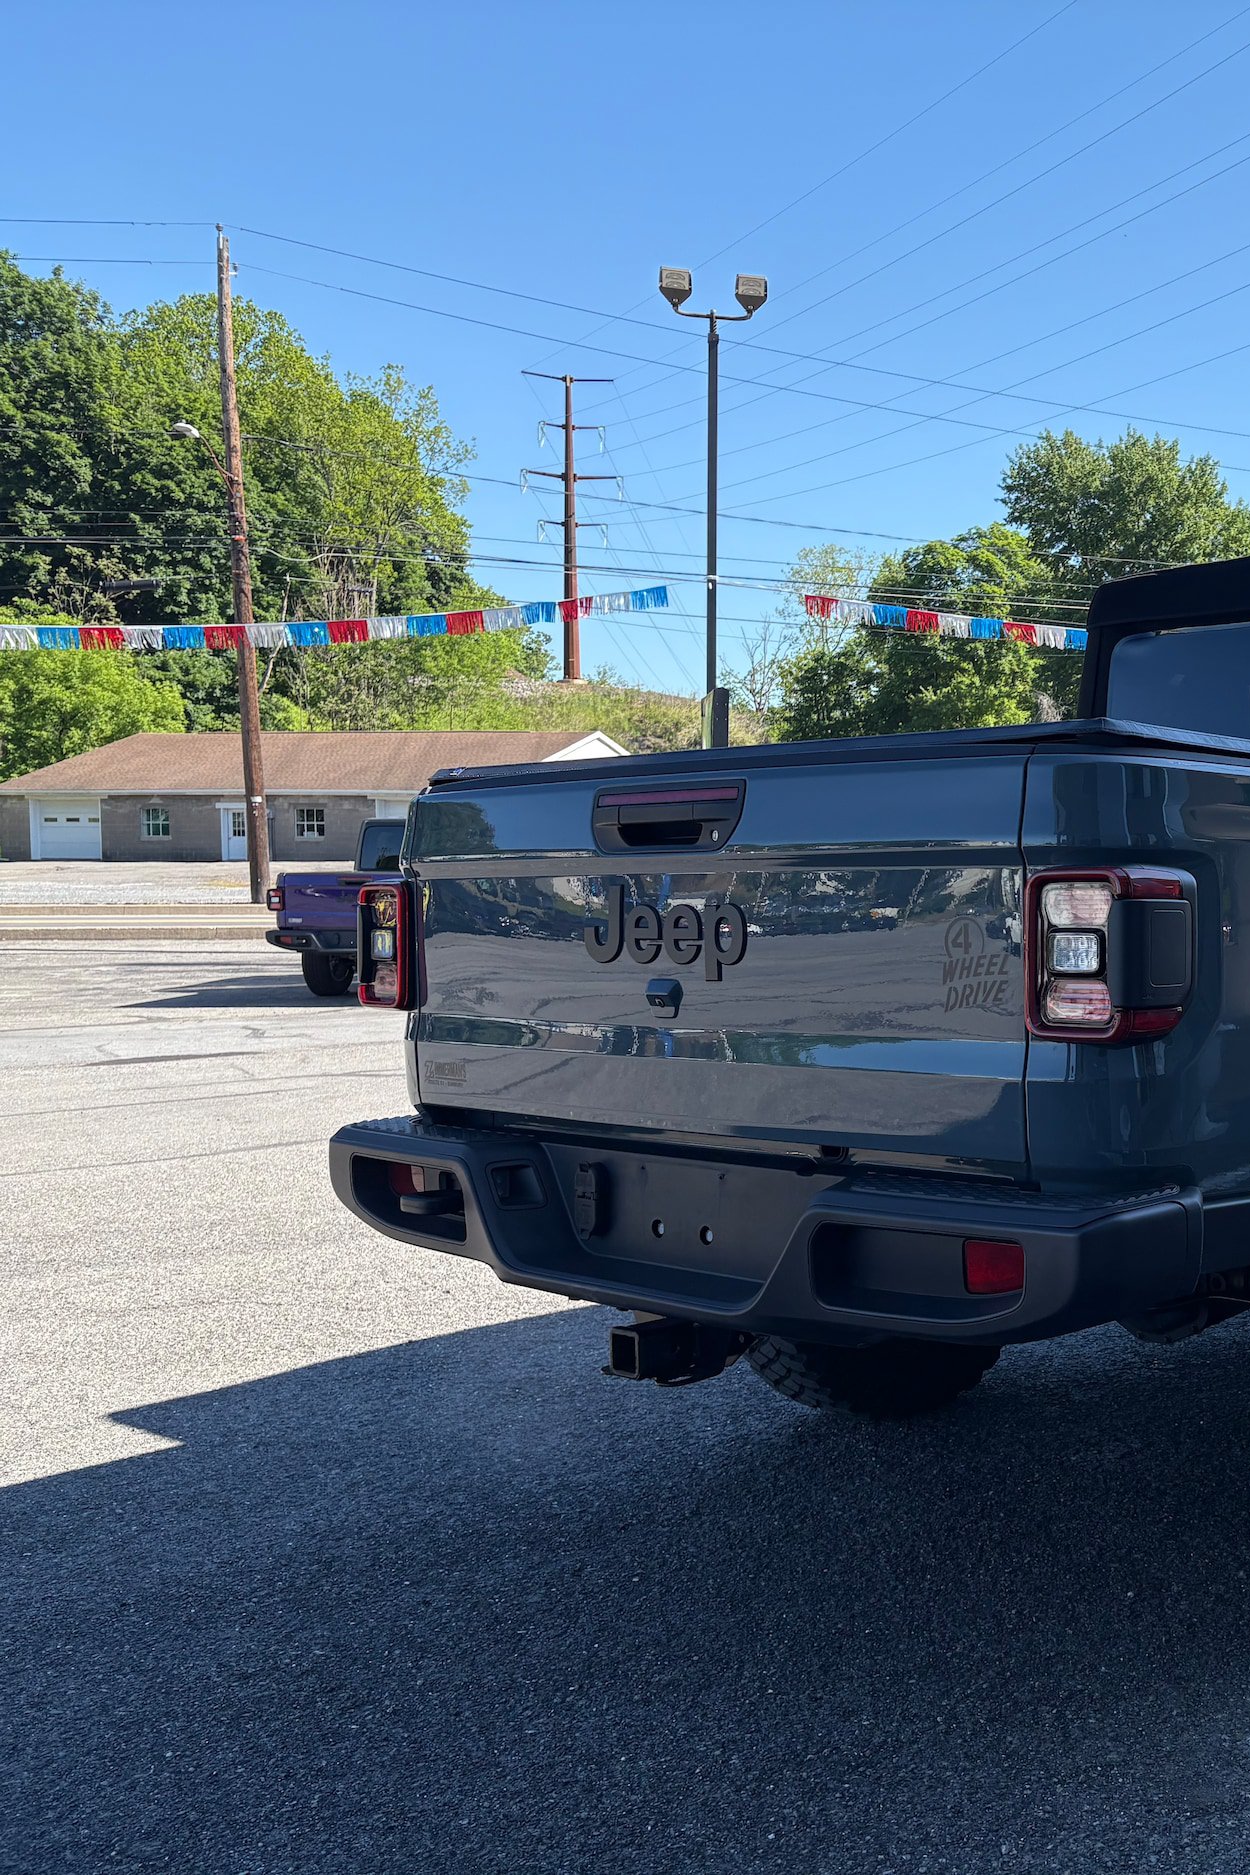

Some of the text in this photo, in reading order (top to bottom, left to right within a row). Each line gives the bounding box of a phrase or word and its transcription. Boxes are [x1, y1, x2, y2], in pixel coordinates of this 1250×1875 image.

[584, 884, 748, 981] Jeep
[951, 922, 972, 955] 4
[942, 954, 1010, 985] WHEEL
[944, 980, 1009, 1013] DRIVE
